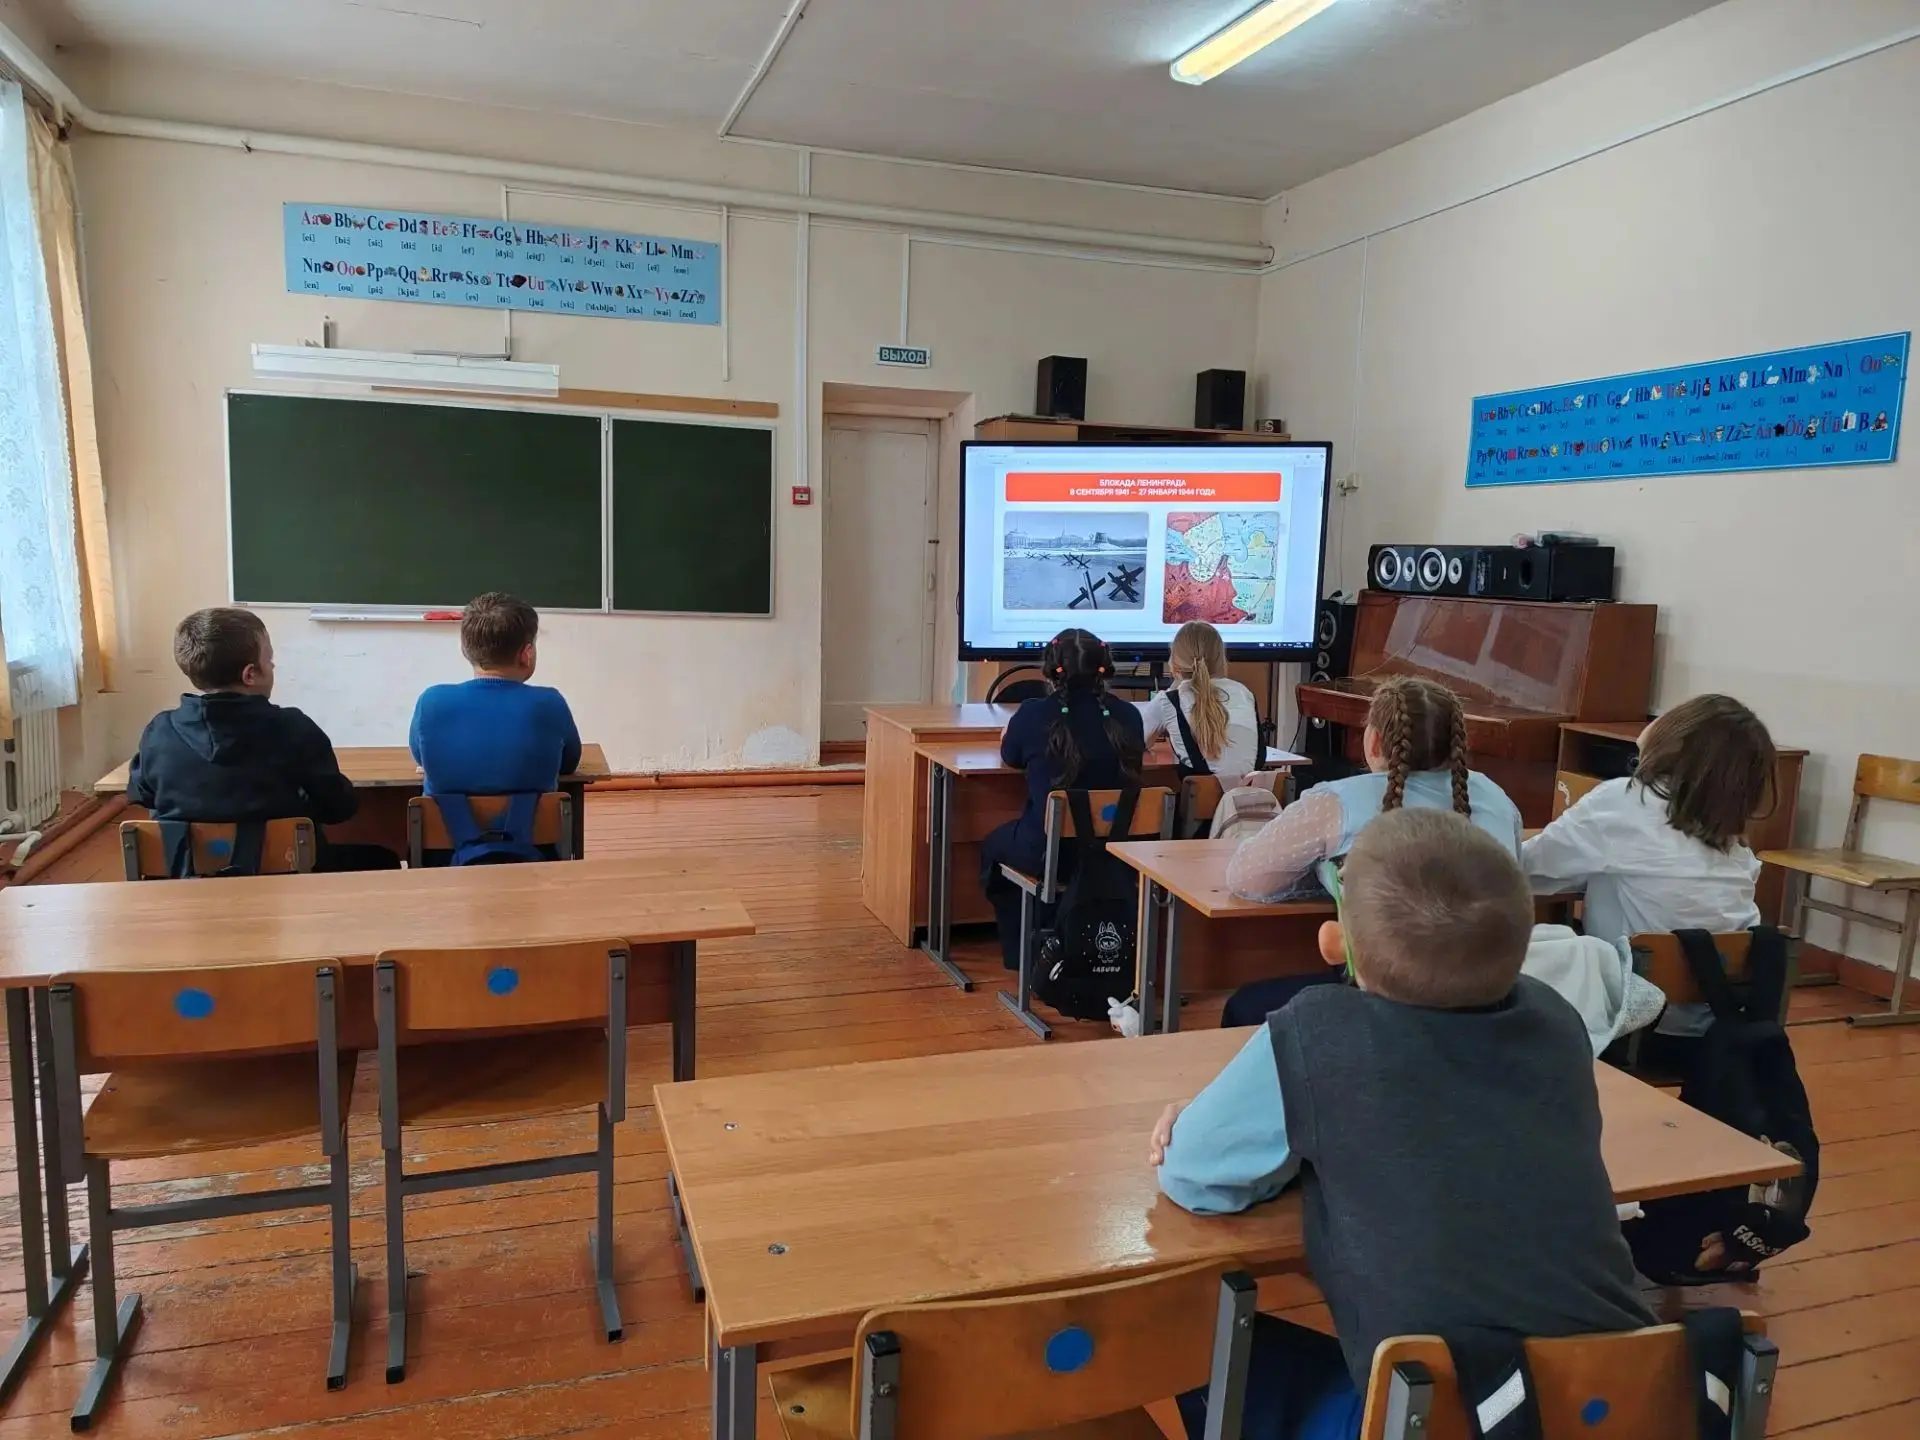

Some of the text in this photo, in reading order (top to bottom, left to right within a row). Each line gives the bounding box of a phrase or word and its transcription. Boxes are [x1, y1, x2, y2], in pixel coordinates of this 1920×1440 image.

[302, 210, 694, 260] Aa Bb Cc Dd Ee Ff Gg Hh Ii Jj Kk Ll Mm
[302, 257, 696, 304] Nn Oo Pp Qq Rr Ss Tt Uu Vv Ww Xx Yy Zz
[881, 348, 924, 363] ВЫХОД
